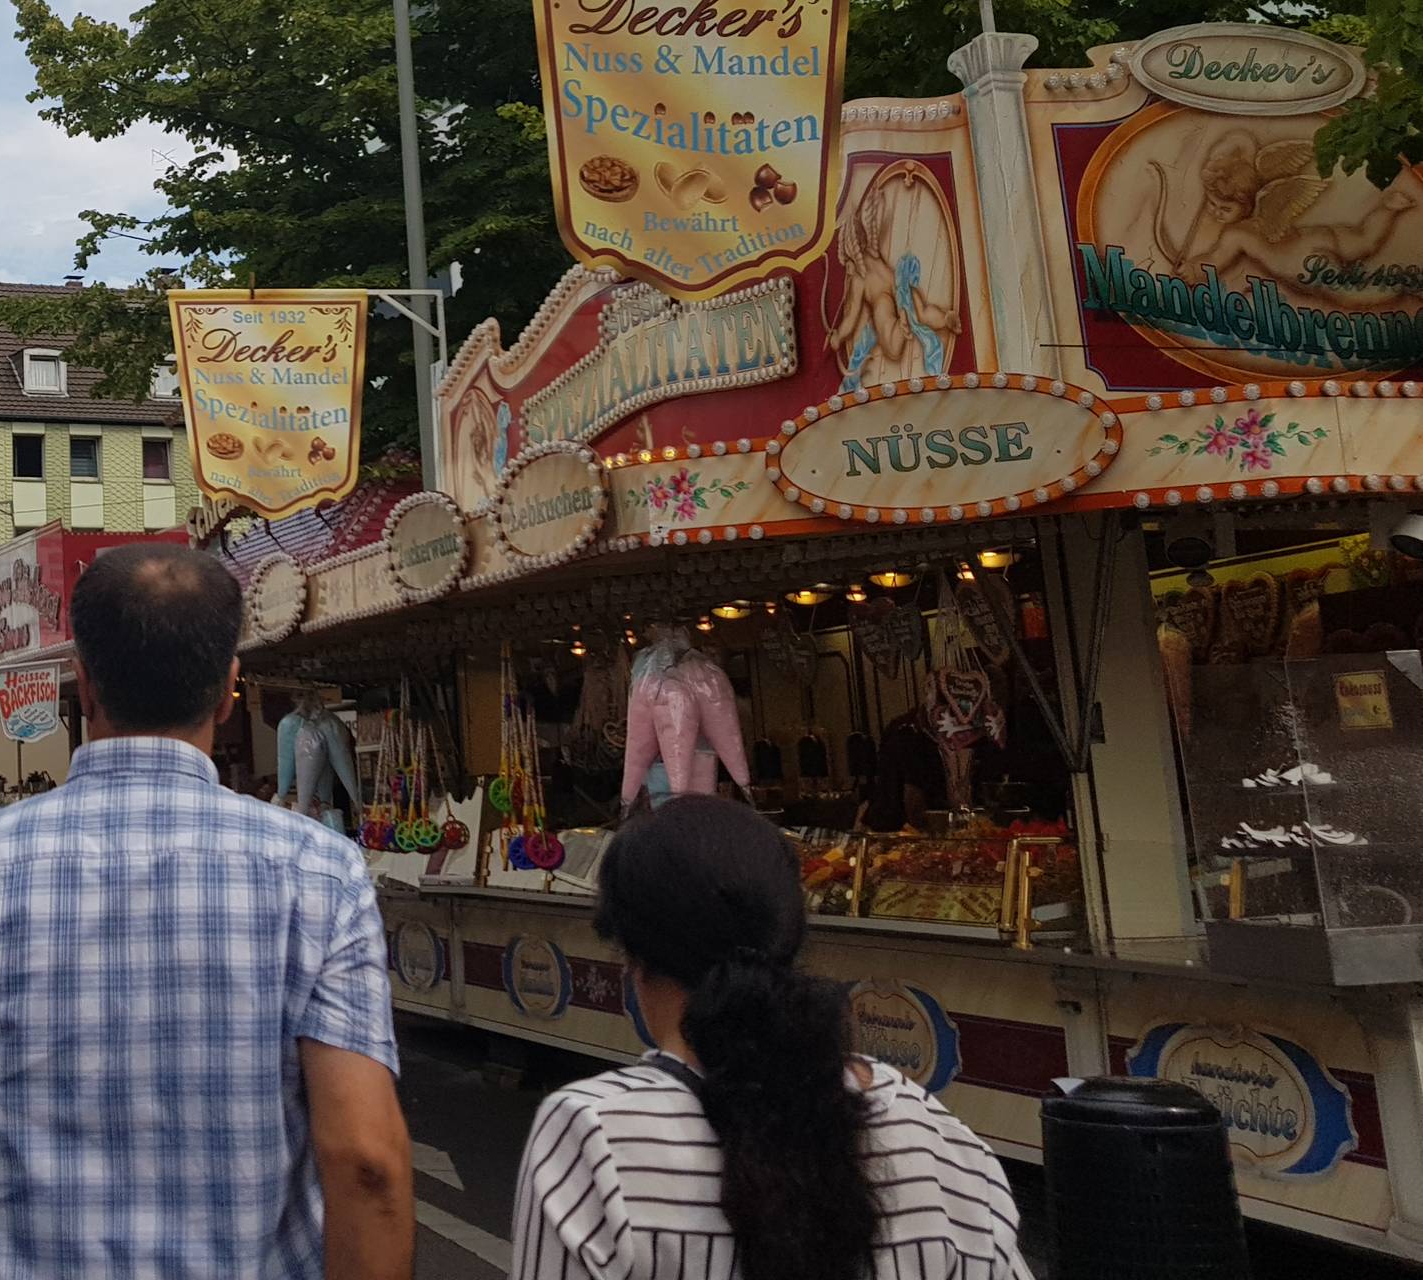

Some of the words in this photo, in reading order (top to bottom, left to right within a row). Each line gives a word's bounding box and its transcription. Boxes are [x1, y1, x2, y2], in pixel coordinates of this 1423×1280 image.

[568, 0, 821, 38] Decker's
[564, 42, 643, 74] Nuss
[654, 45, 683, 75] &
[692, 44, 821, 77] Mandel
[1166, 42, 1337, 85] Decker's
[562, 78, 821, 156] Spezialitäten
[643, 211, 739, 234] Bewährt
[583, 220, 633, 252] nach
[644, 246, 693, 281] alter
[697, 220, 805, 277] Tradition
[233, 310, 262, 323] Seit
[270, 310, 305, 324] 1932
[197, 328, 338, 363] Decker's
[194, 367, 244, 385] Nuss
[250, 369, 264, 385] &
[272, 367, 348, 385] Mandel
[194, 388, 349, 432] Spezialitäten
[842, 422, 1033, 477] NÜSSE
[210, 470, 242, 490] nach
[507, 484, 593, 533] Lebkuchen
